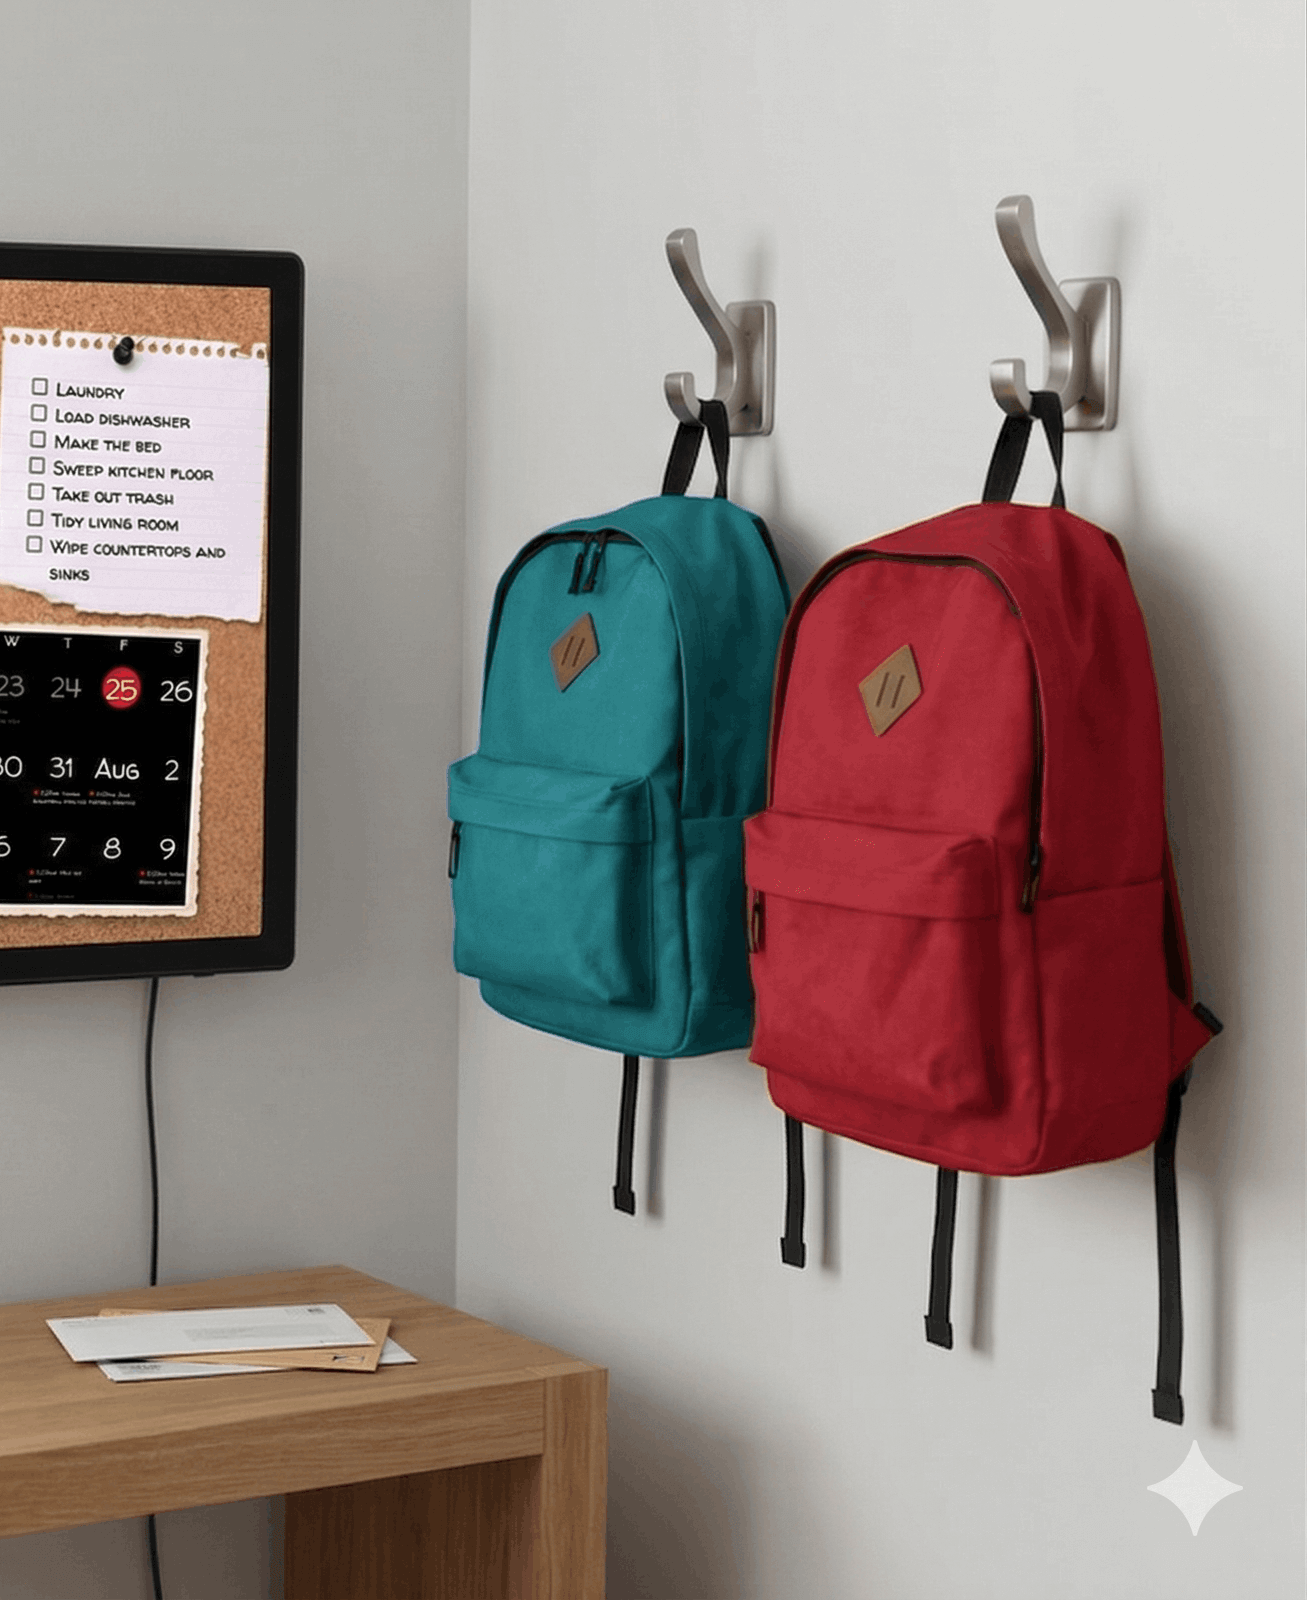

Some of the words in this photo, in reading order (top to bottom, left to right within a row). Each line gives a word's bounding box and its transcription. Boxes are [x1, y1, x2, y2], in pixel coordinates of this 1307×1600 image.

[57, 383, 124, 399] LAUNDRY
[56, 409, 94, 424] LOAD
[100, 414, 190, 428] DISHWASHER
[55, 435, 98, 450] MAKE
[103, 440, 130, 451] THE
[136, 441, 161, 453] BED
[53, 460, 103, 476] SWEEP
[108, 467, 165, 478] KITCHEN
[52, 487, 89, 502] TAKE
[94, 491, 122, 503] OUT
[126, 493, 173, 505] TRASH
[51, 513, 84, 528] TIDY
[89, 518, 132, 530] LIVING
[138, 519, 178, 531] ROOM
[50, 540, 88, 555] WIPE
[94, 544, 191, 558] COUNTERTOPS
[196, 548, 225, 558] AND
[50, 569, 89, 581] SINKS
[4, 636, 19, 646] W
[64, 638, 72, 648] T
[120, 639, 128, 650] F
[174, 641, 183, 653] S
[51, 677, 81, 698] 24
[105, 677, 138, 701] 25
[161, 681, 192, 702] 26
[50, 757, 72, 778] 31
[95, 758, 139, 780] AUG
[165, 760, 178, 780] 2
[51, 838, 66, 856] 7
[104, 837, 121, 859] 8
[160, 839, 175, 860] 9
